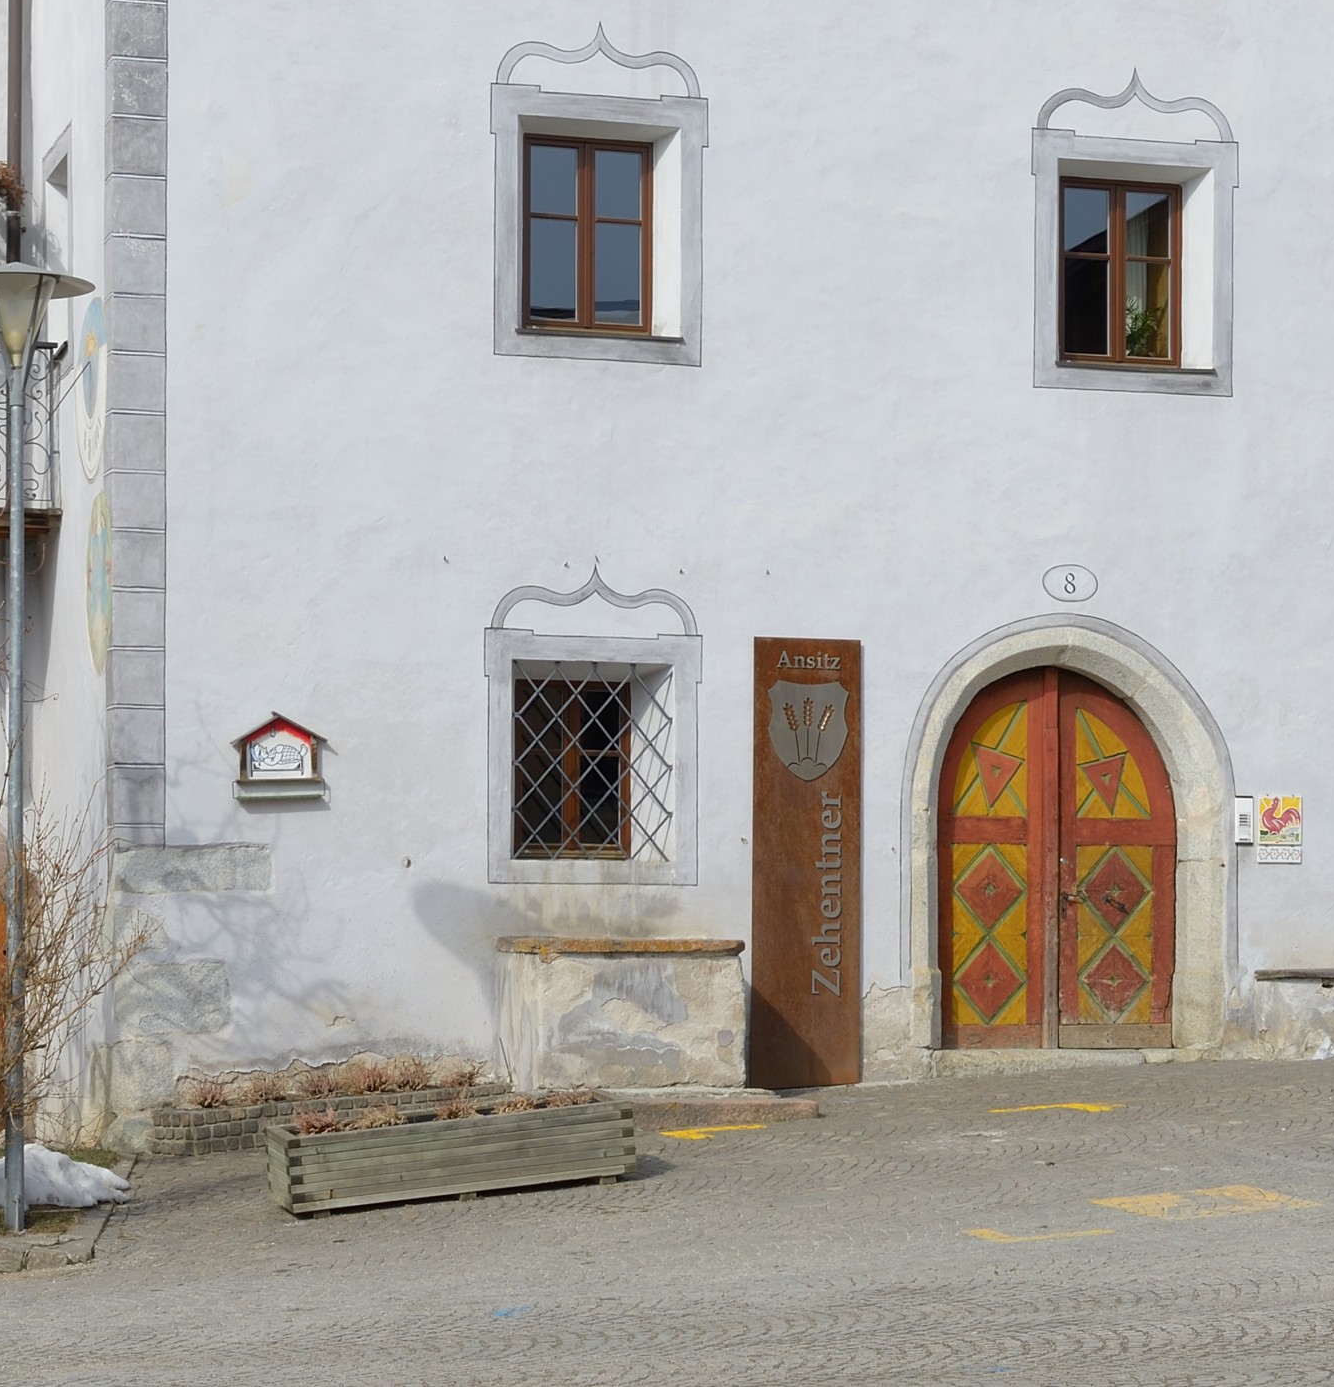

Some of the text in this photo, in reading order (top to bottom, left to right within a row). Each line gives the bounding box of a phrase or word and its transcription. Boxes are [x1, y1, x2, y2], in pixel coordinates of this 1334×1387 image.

[1064, 572, 1076, 595] 8
[776, 650, 841, 671] Ansitz
[811, 791, 843, 998] Zehentner
